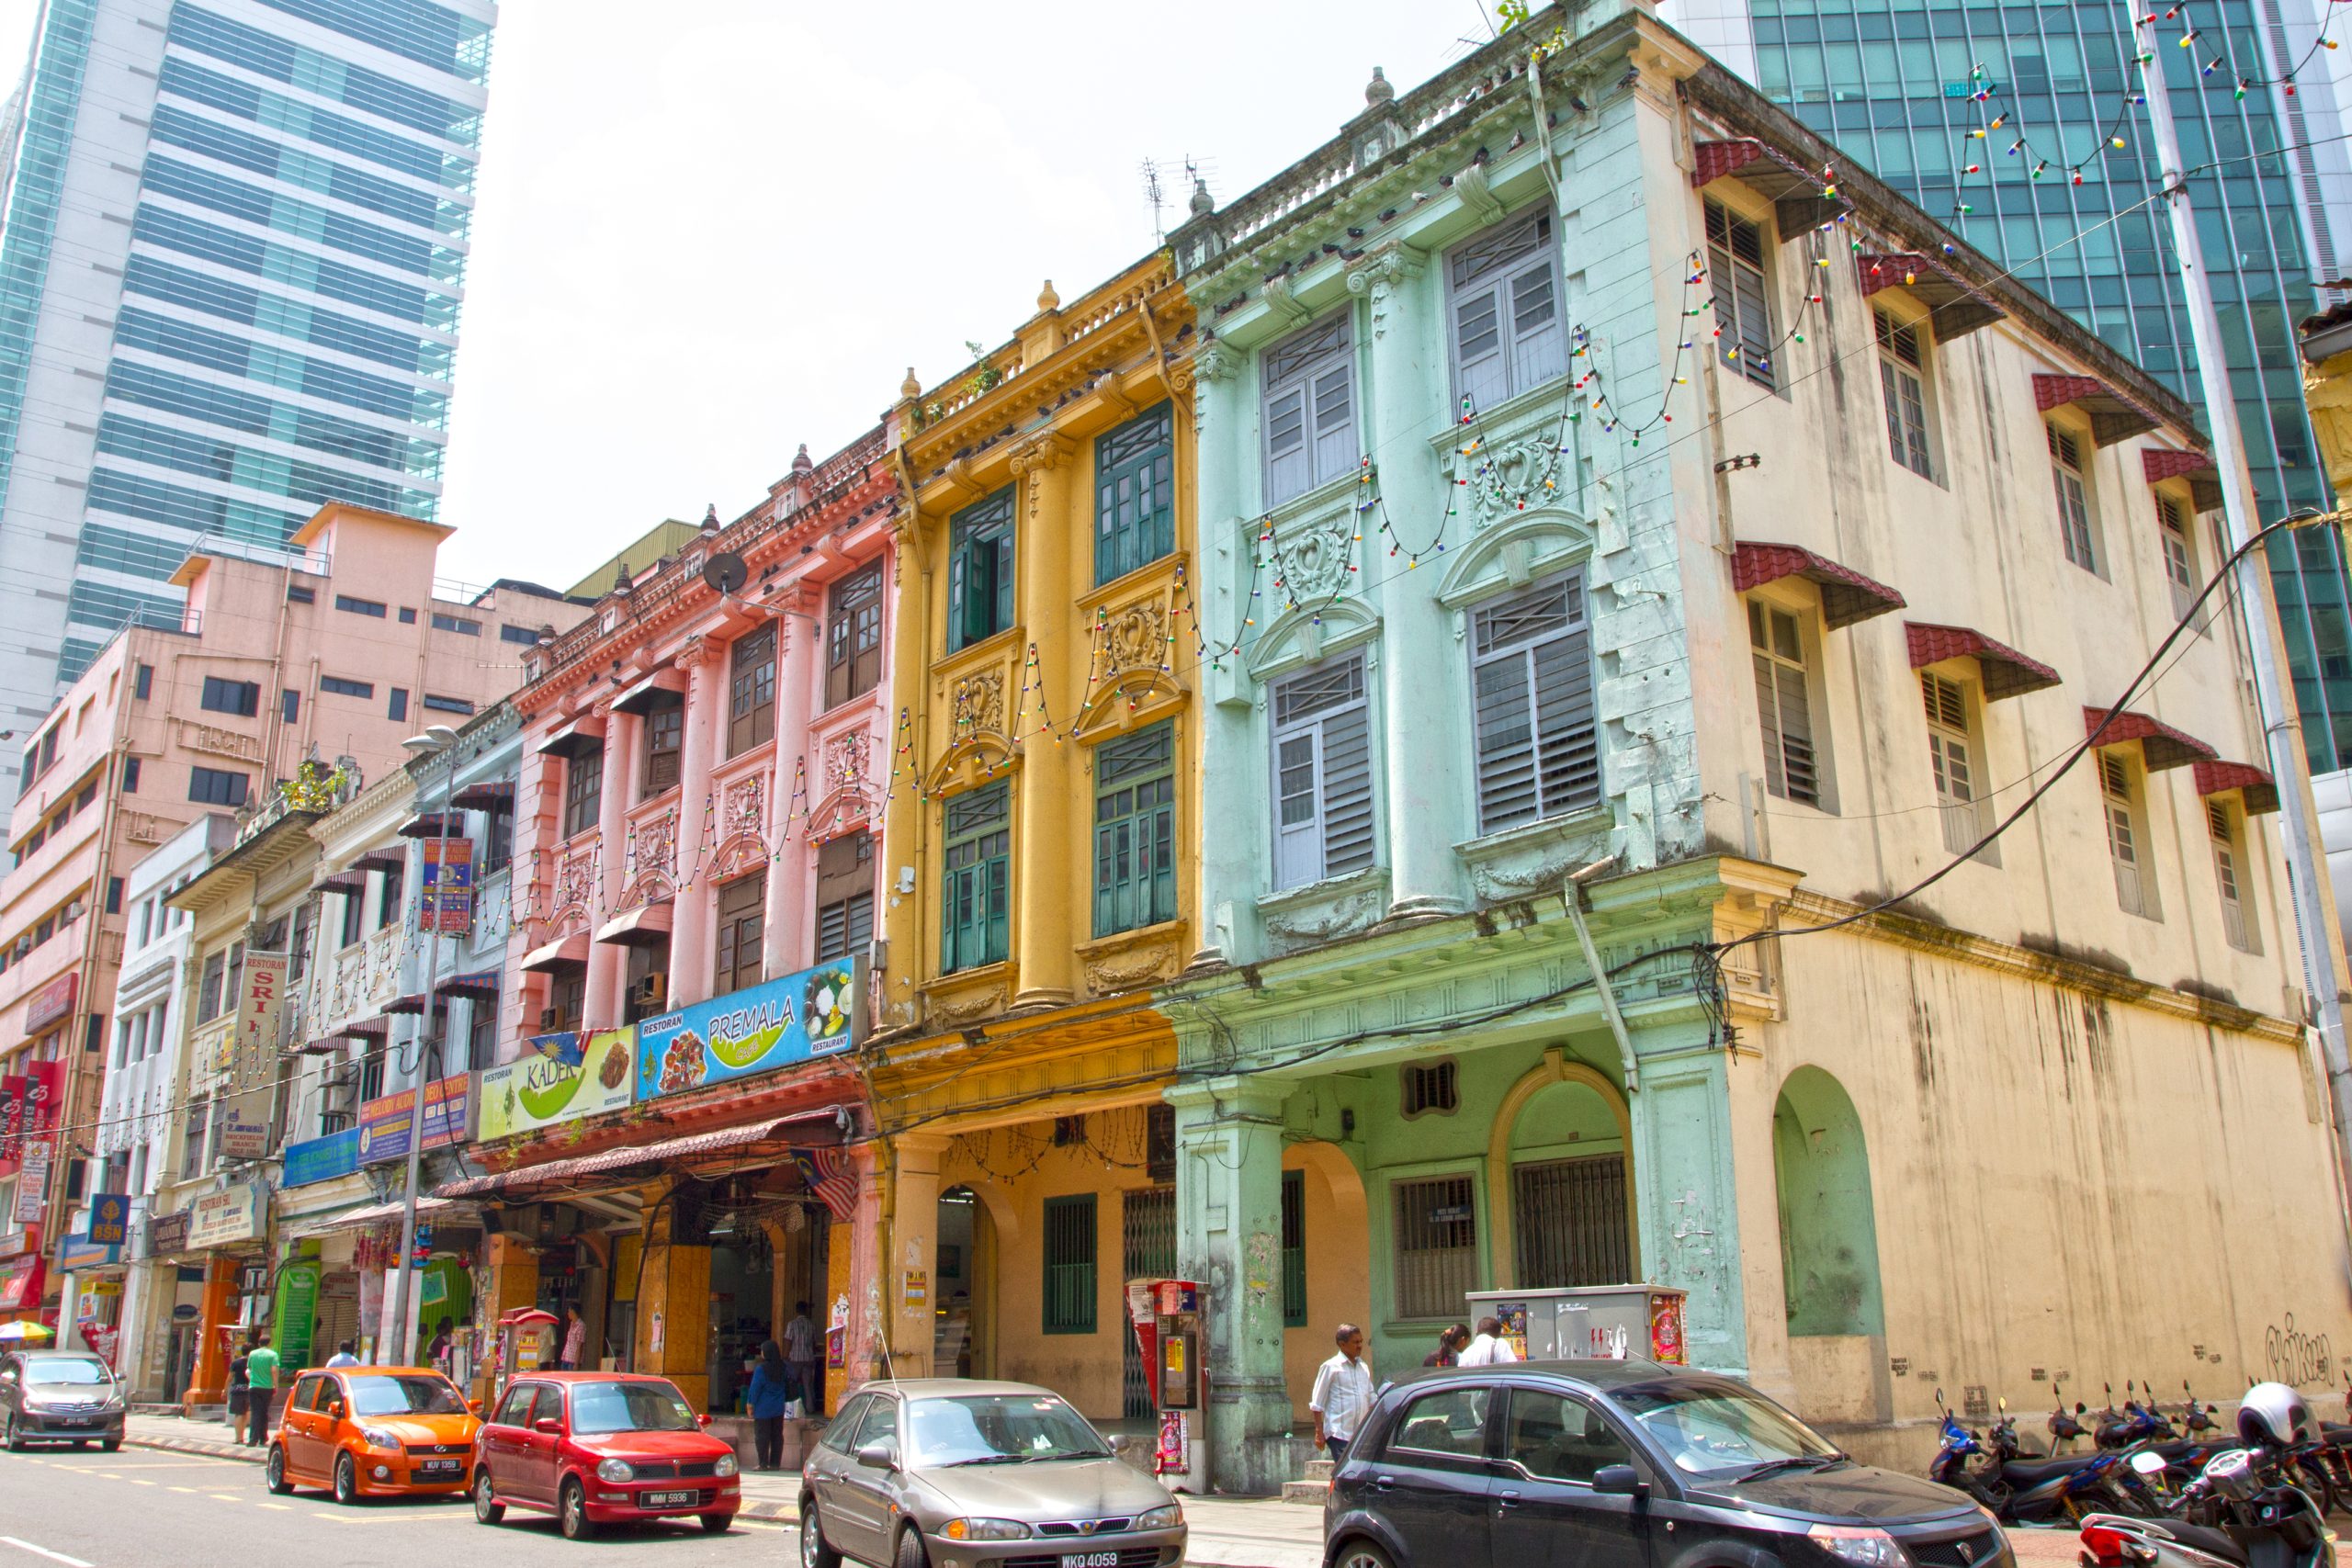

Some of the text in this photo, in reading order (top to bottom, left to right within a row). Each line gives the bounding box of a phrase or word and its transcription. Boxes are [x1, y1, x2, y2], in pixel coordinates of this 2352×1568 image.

[452, 845, 470, 854] AUDIO
[247, 958, 286, 970] RESTORAN
[250, 972, 275, 1013] SRI
[643, 1015, 683, 1035] RESTORAN
[708, 997, 795, 1044] PREMALA
[811, 1035, 848, 1052] RESTAURANT
[483, 1067, 514, 1083] RESTORAN
[369, 1097, 399, 1118] MELODY
[396, 1092, 415, 1110] AUDIO
[425, 1085, 439, 1100] DEO
[604, 1094, 629, 1107] RESTAURANT
[198, 1193, 232, 1213] RESTORAN SRI
[94, 1226, 122, 1240] BSN
[668, 1493, 687, 1503] 5936
[1062, 1552, 1117, 1568] WKQ 4059
